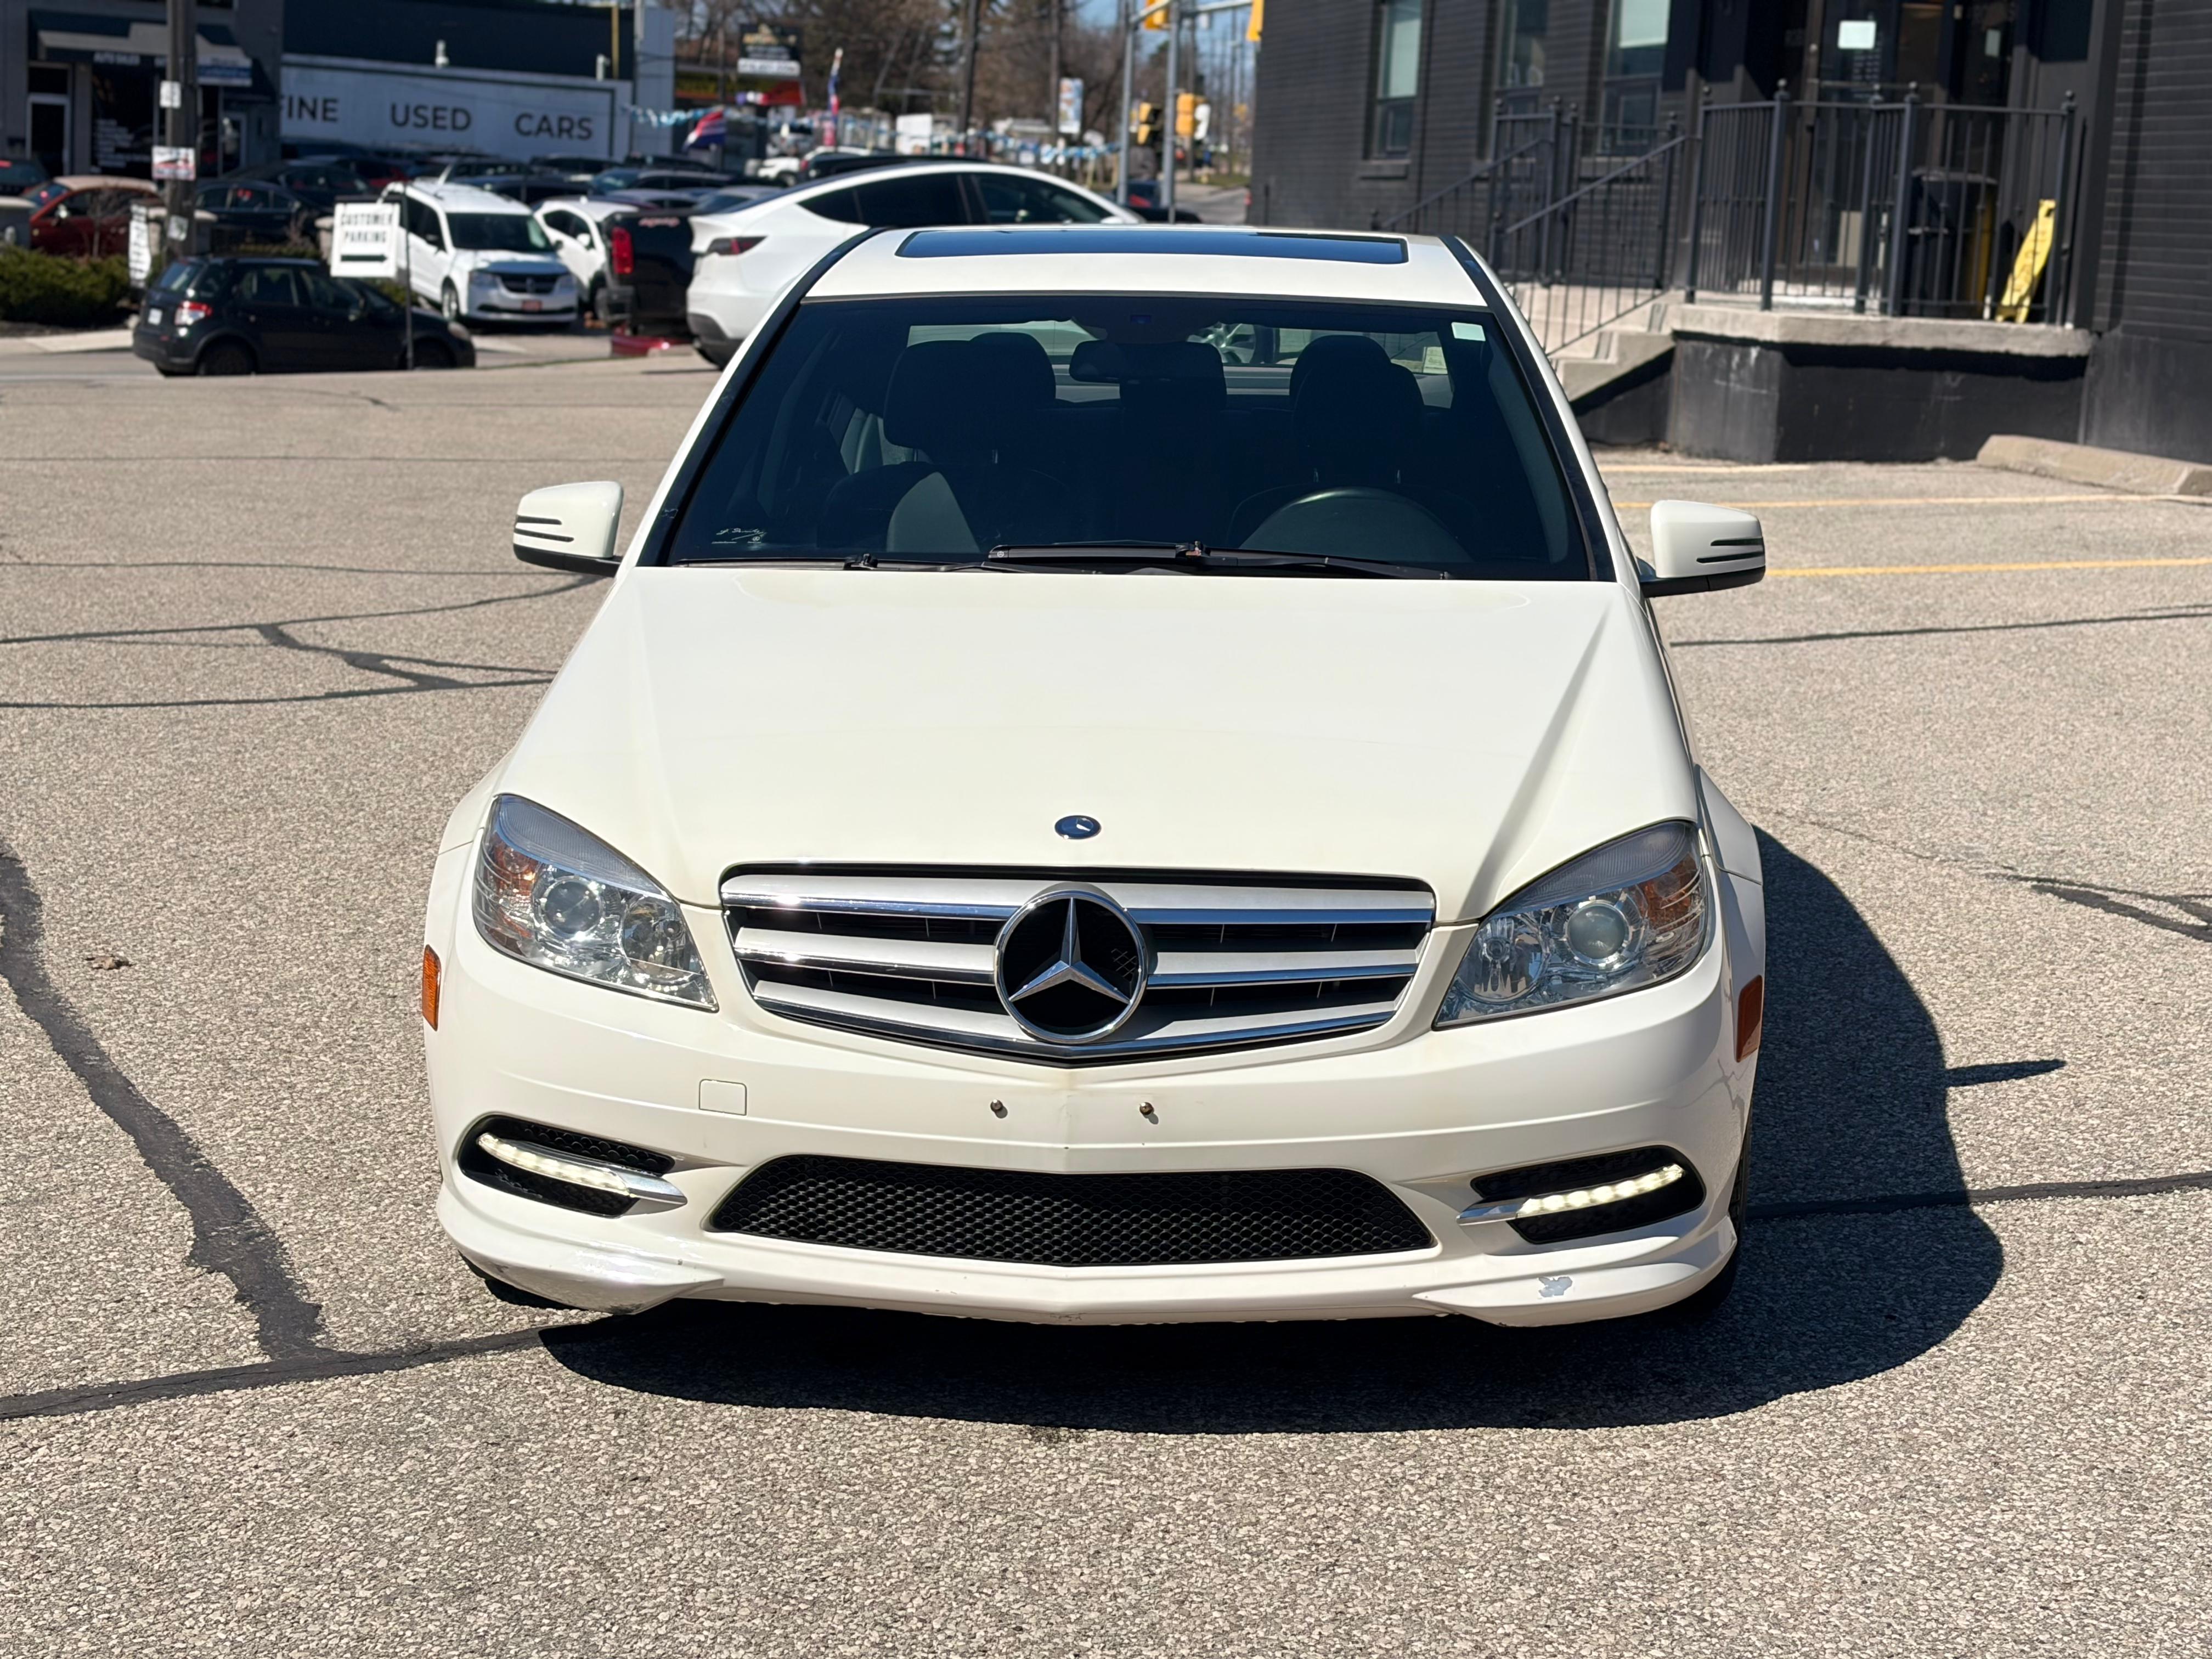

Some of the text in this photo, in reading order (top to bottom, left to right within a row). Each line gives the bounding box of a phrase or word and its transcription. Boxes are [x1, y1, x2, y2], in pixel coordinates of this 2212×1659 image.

[390, 103, 472, 132] USED
[515, 112, 593, 141] CARS
[341, 213, 393, 225] CUSTOMER
[345, 230, 387, 242] PARKING
